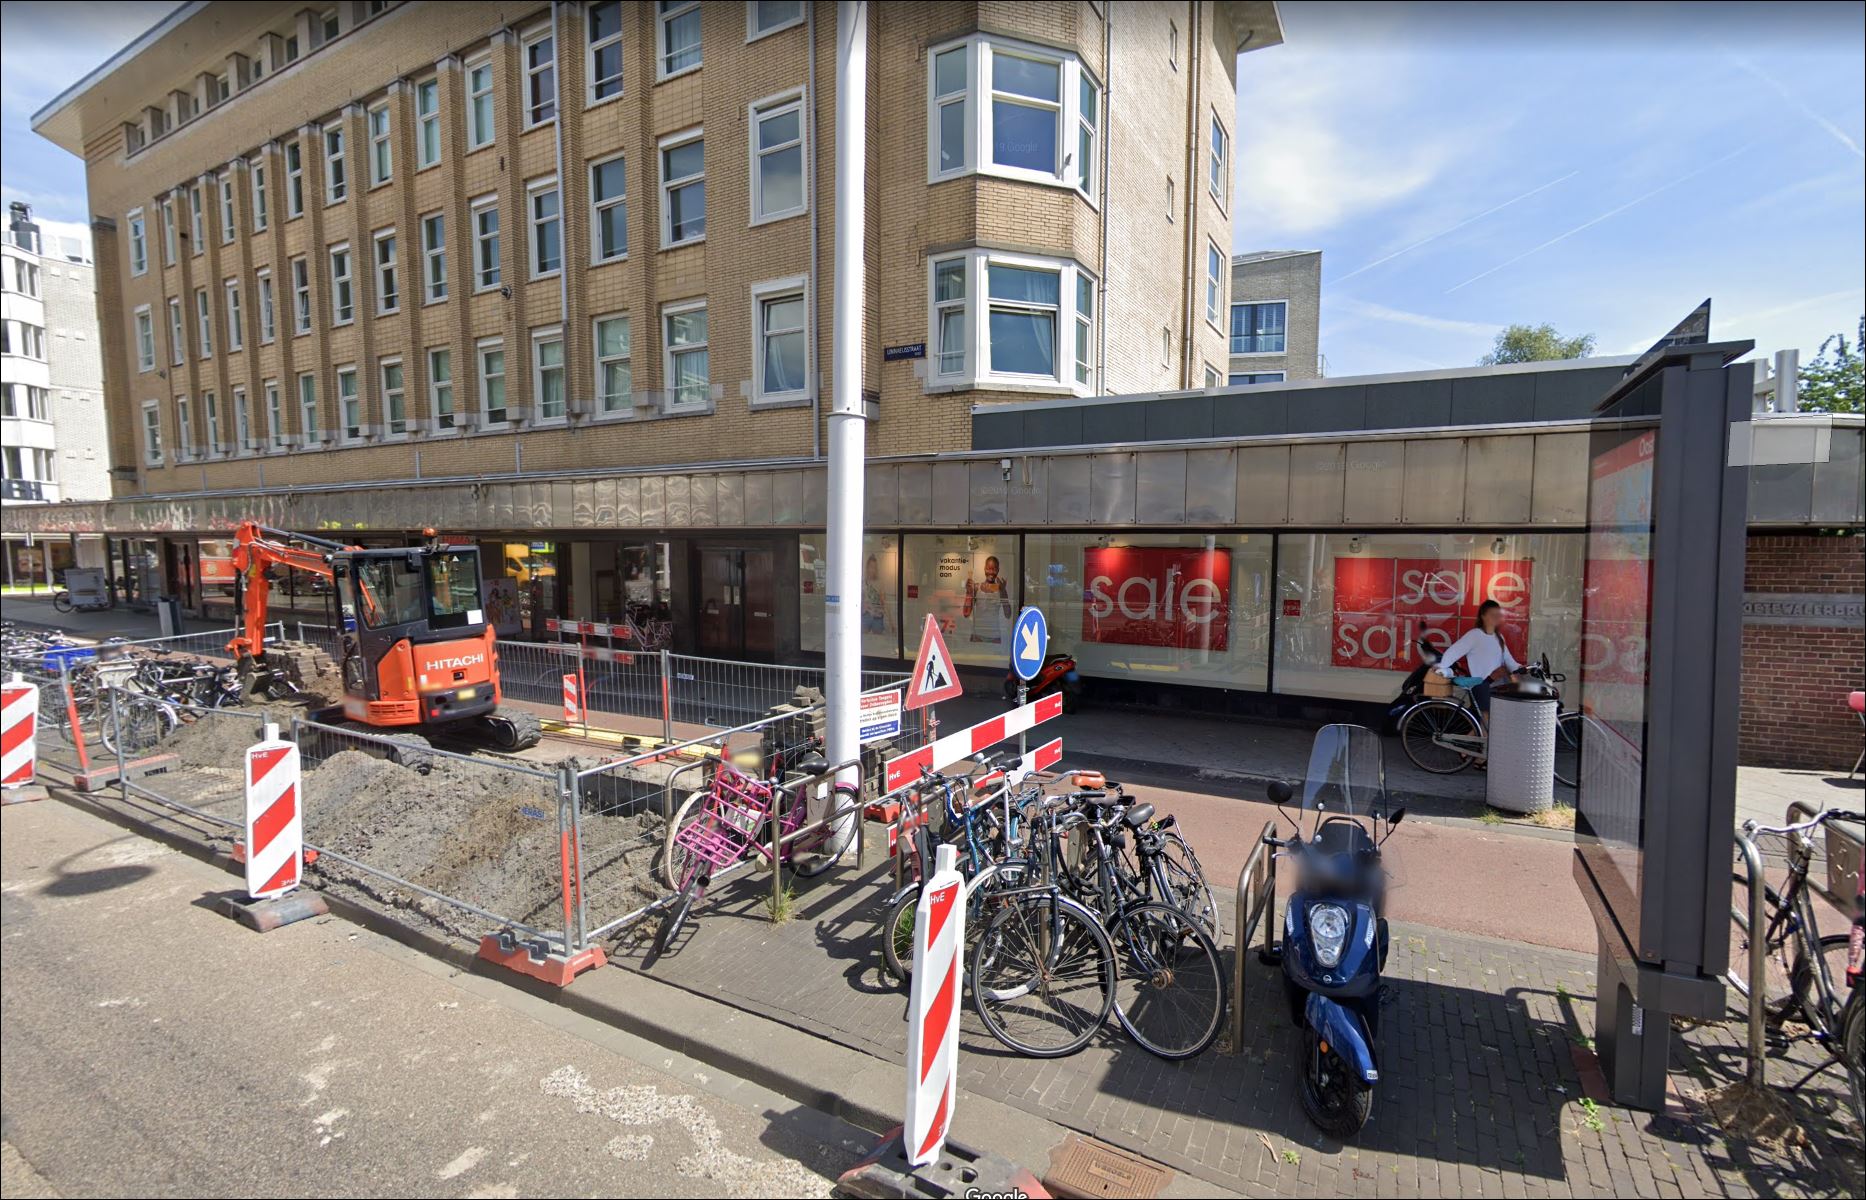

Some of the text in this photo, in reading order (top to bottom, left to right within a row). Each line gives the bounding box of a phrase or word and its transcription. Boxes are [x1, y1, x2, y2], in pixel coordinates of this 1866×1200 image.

[1089, 566, 1221, 624] sale
[1402, 563, 1526, 608] sale
[1336, 618, 1452, 662] sale
[426, 652, 484, 671] HITACHI
[251, 752, 269, 760] HvE
[889, 769, 901, 781] HvE
[930, 891, 945, 905] HvE
